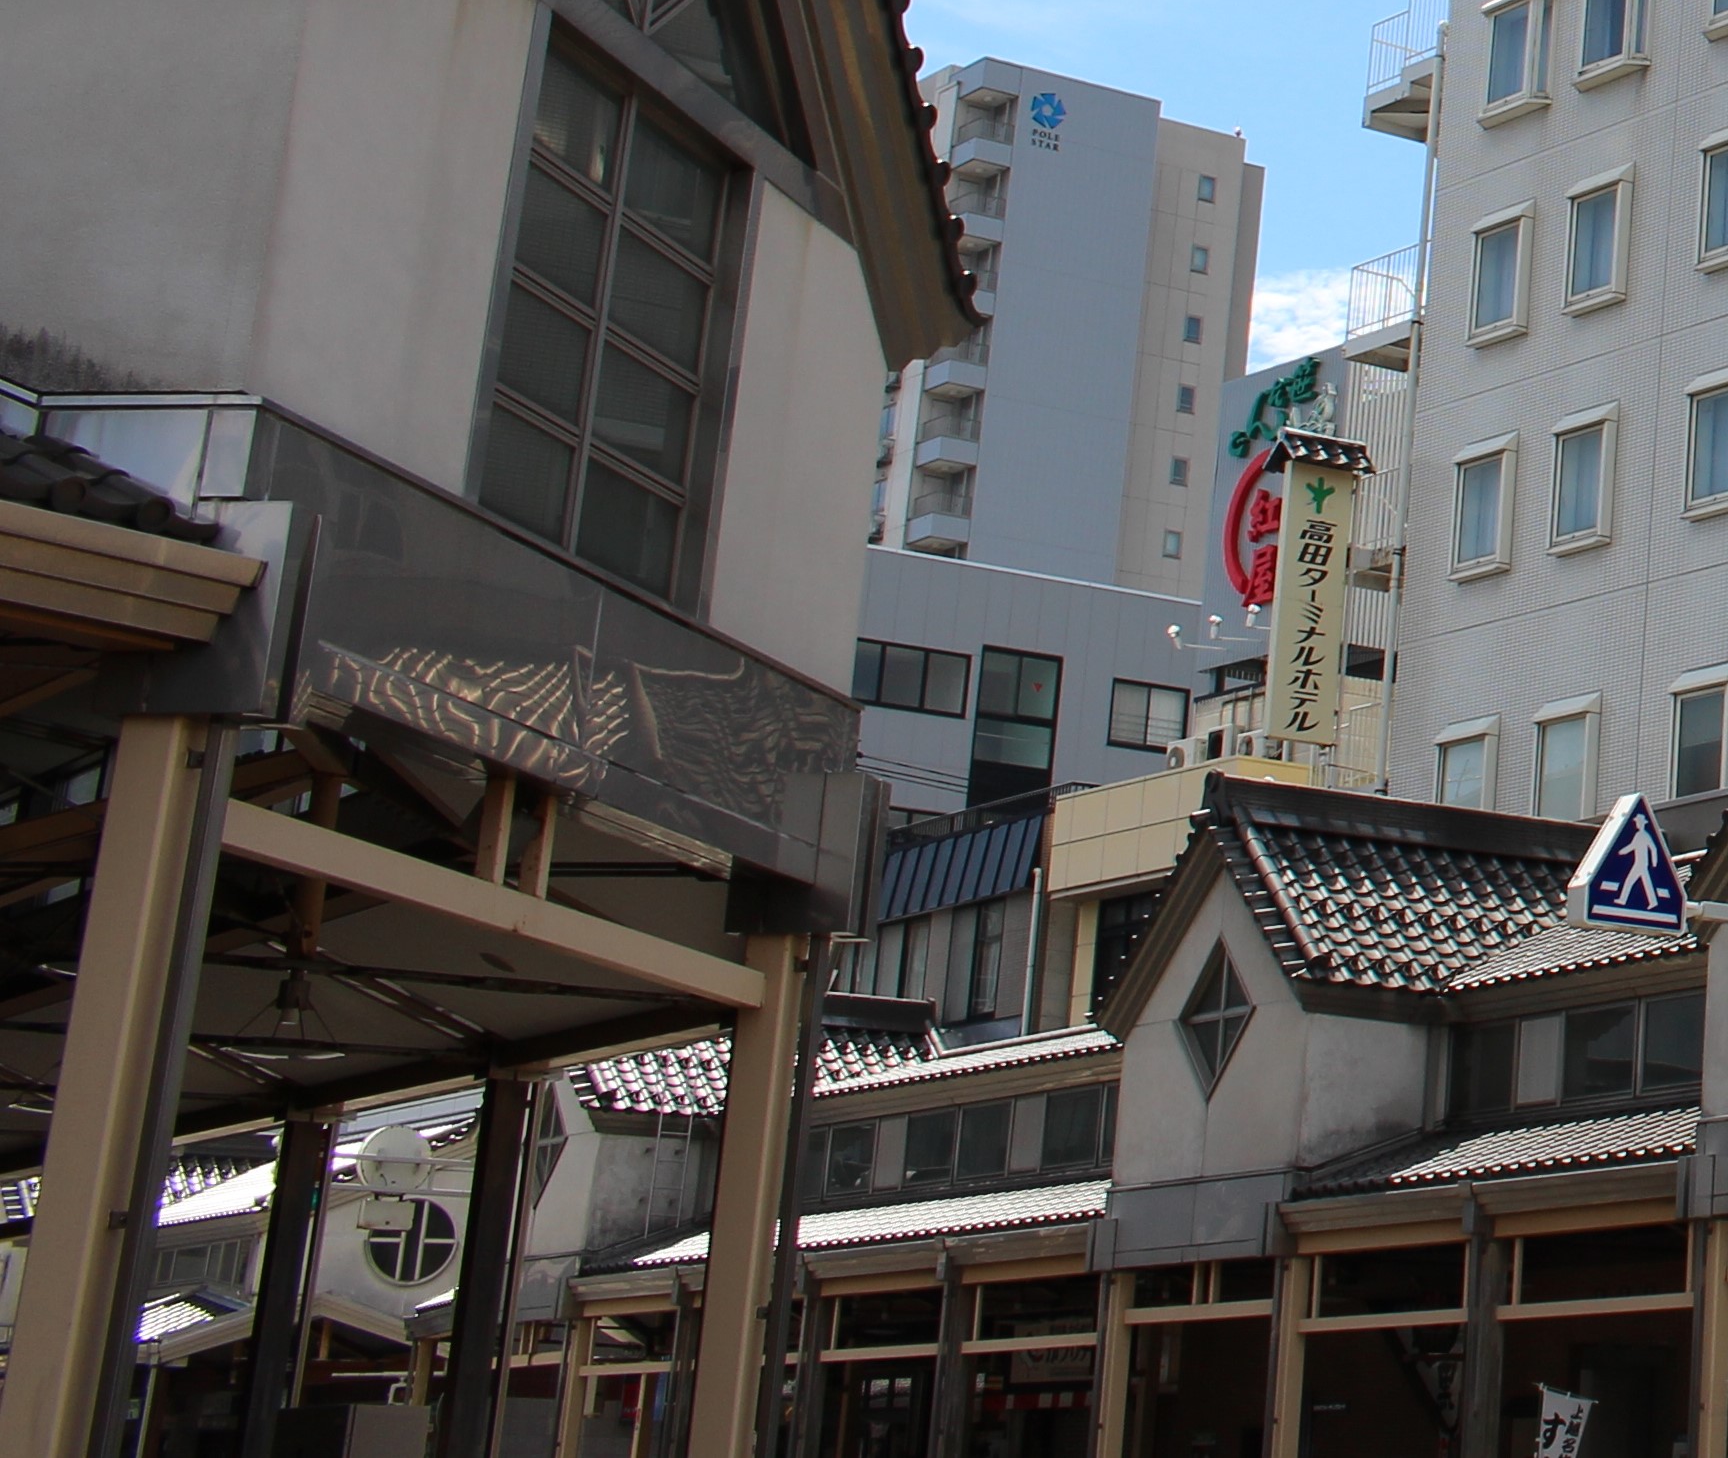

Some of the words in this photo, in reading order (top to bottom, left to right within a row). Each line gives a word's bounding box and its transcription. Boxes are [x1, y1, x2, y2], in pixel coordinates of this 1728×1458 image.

[1031, 138, 1060, 152] STAR
[1032, 128, 1060, 142] POLE
[1284, 519, 1338, 732] 高田ターミナルホテル
[1542, 1412, 1567, 1458] す
[1558, 1403, 1584, 1458] 上越名
